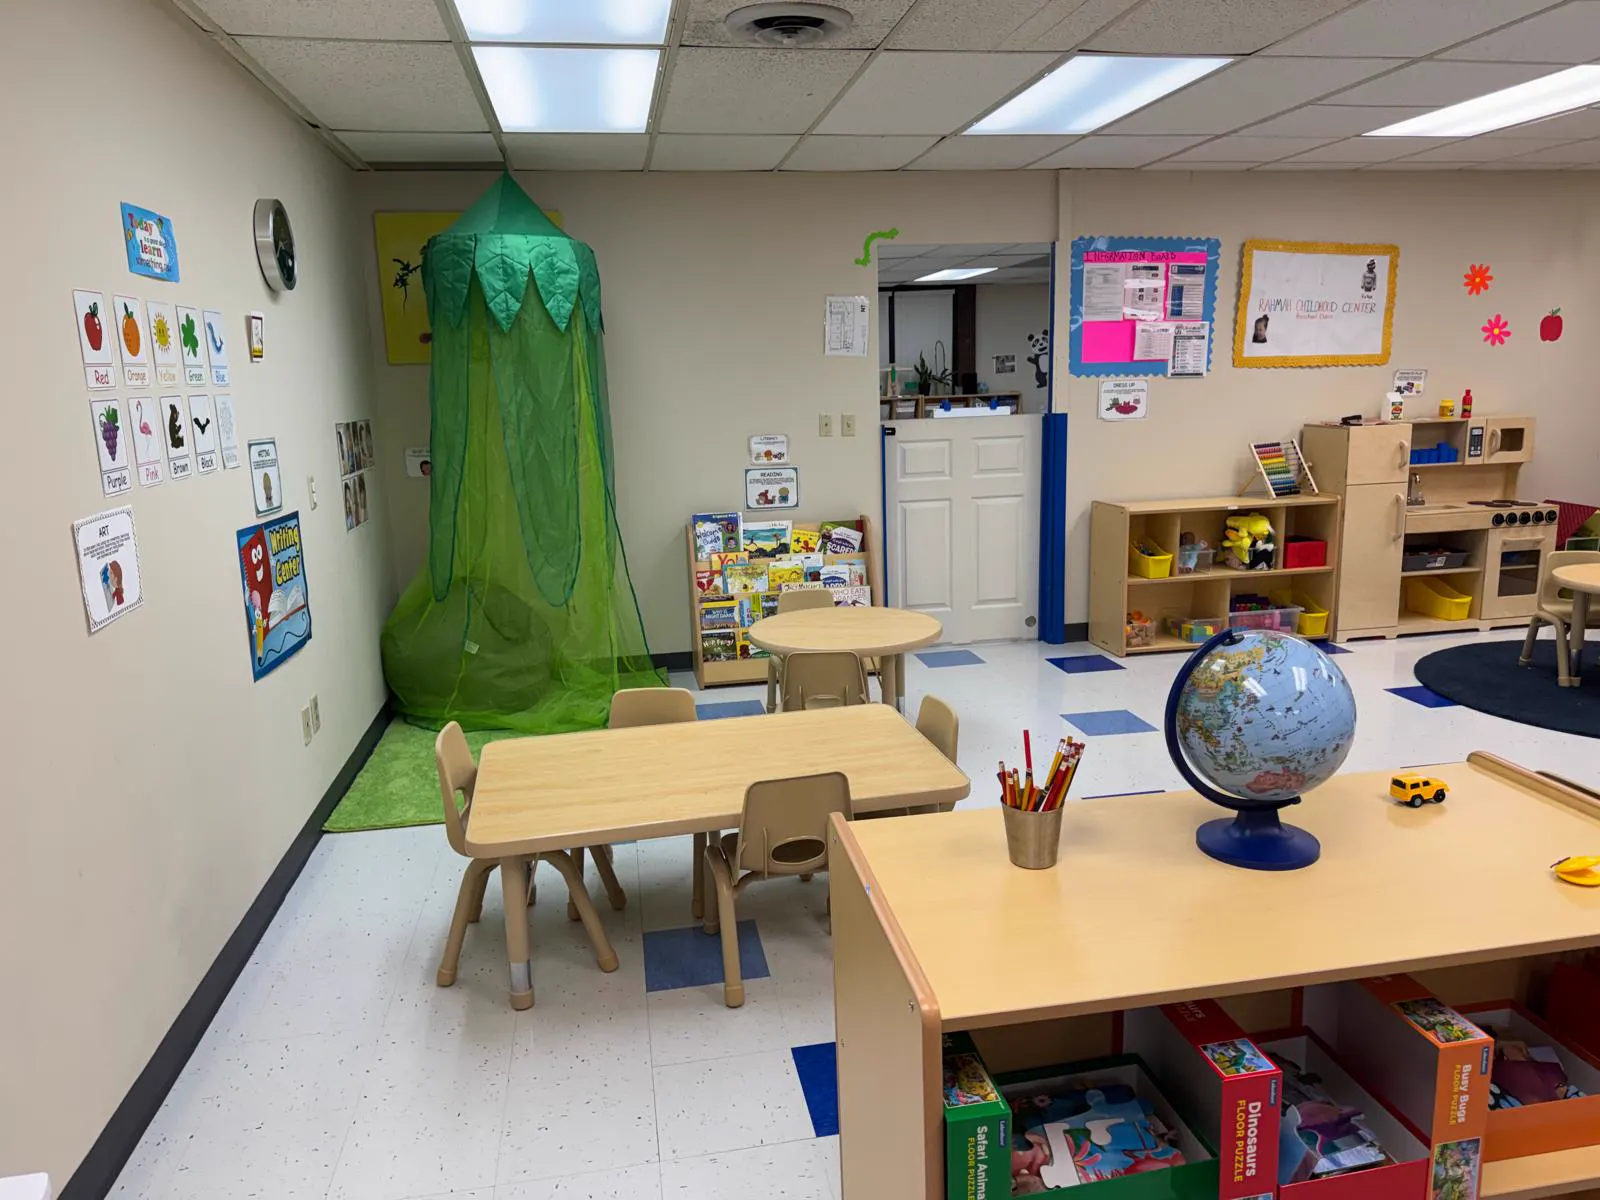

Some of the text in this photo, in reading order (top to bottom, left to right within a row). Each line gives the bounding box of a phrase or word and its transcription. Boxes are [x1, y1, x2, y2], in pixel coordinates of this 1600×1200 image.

[128, 213, 153, 236] Today
[140, 240, 162, 258] learn
[1258, 298, 1376, 314] RAHMAH CHILDHOOD CENTER
[94, 369, 110, 385] Red
[127, 369, 147, 384] Orange
[158, 368, 177, 381] Yellow
[188, 369, 204, 381] Green
[215, 370, 226, 383] Blue
[173, 462, 189, 475] Brown
[201, 456, 214, 469] Black
[145, 467, 159, 481] Pink
[106, 475, 128, 491] Purple
[99, 524, 110, 538] ART
[696, 526, 722, 540] Welcome
[269, 523, 300, 557] Writing
[276, 554, 300, 587] Center
[851, 587, 866, 595] EATS
[1449, 1064, 1461, 1125] FLOOR PUZZLE
[1456, 1064, 1472, 1123] Busy Bugs
[1234, 1099, 1246, 1182] FLOOR PUZZLE
[1245, 1101, 1262, 1177] Dinosaurs
[967, 1137, 975, 1200] FLOOR PUZZLE
[977, 1125, 988, 1200] Safari Anima
